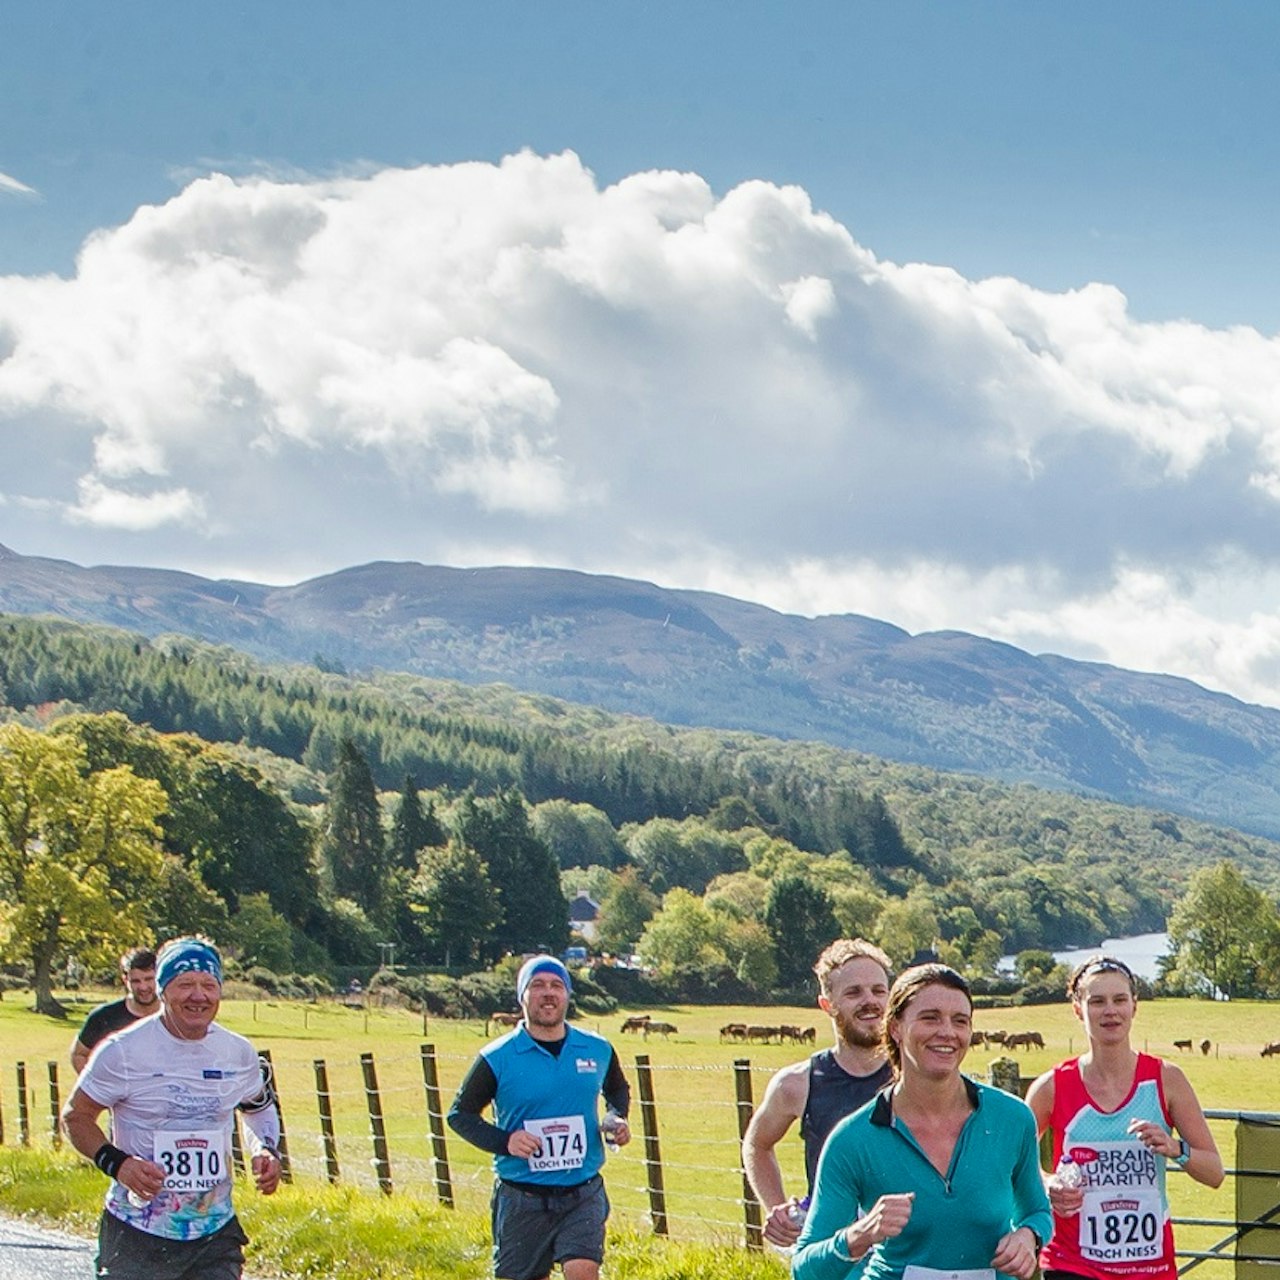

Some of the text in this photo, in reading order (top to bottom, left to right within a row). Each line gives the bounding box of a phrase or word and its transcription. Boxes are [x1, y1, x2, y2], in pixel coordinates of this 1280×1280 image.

[1098, 1149, 1155, 1162] BRAIN
[161, 1151, 220, 1176] 3810
[534, 1157, 585, 1169] LOCH NES
[1086, 1161, 1156, 1175] UMOUR
[1088, 1212, 1157, 1245] 1820
[1088, 1244, 1157, 1259] LOCH NESS
